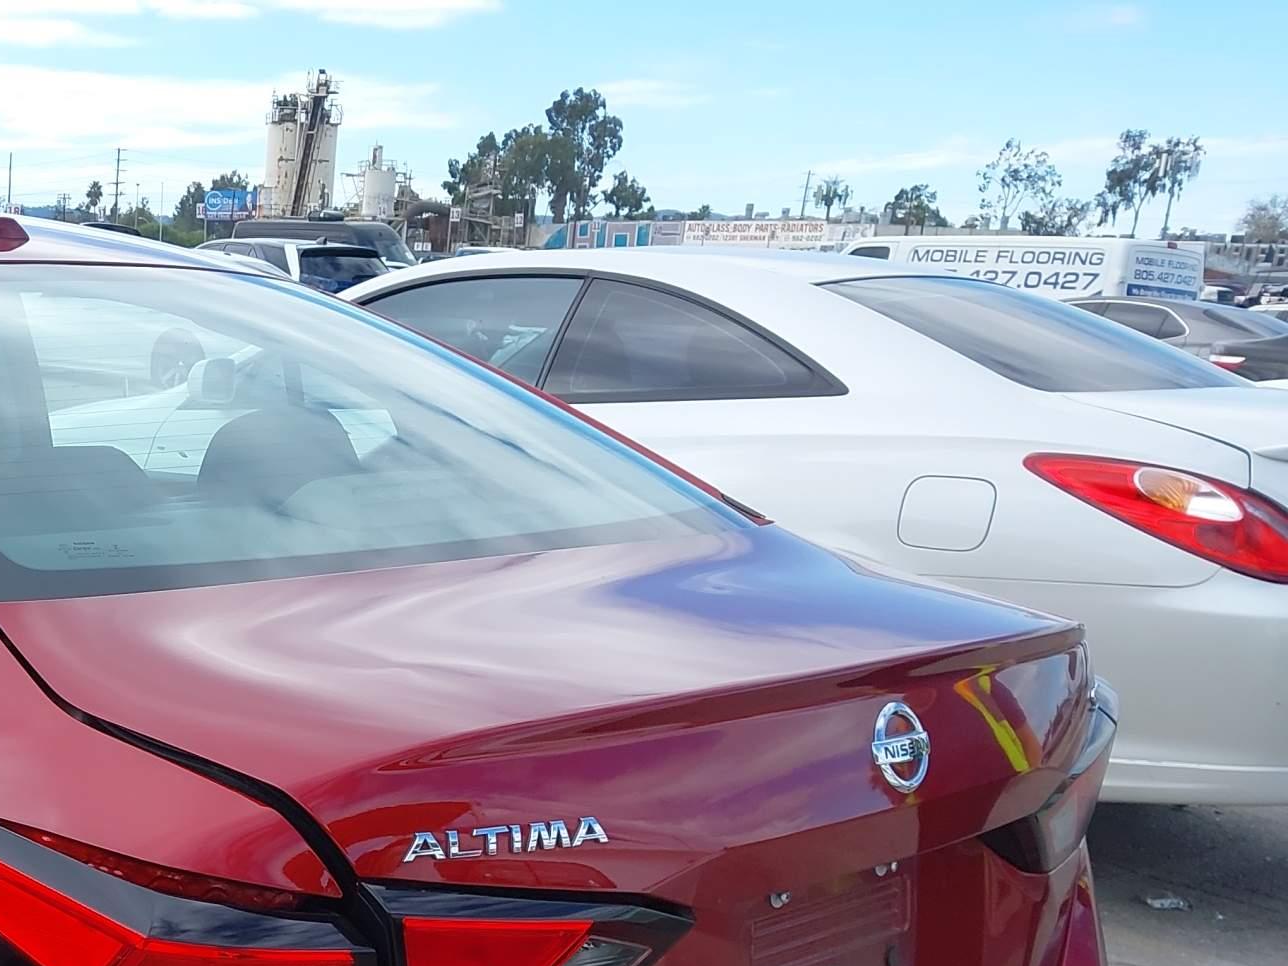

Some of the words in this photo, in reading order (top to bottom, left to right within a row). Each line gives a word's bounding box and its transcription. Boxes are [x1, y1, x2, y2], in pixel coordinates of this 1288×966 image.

[223, 196, 239, 204] Del
[450, 210, 460, 219] 13
[912, 249, 989, 264] MOBILE
[995, 250, 1105, 266] FLOORING
[402, 816, 609, 863] ALTIMA
